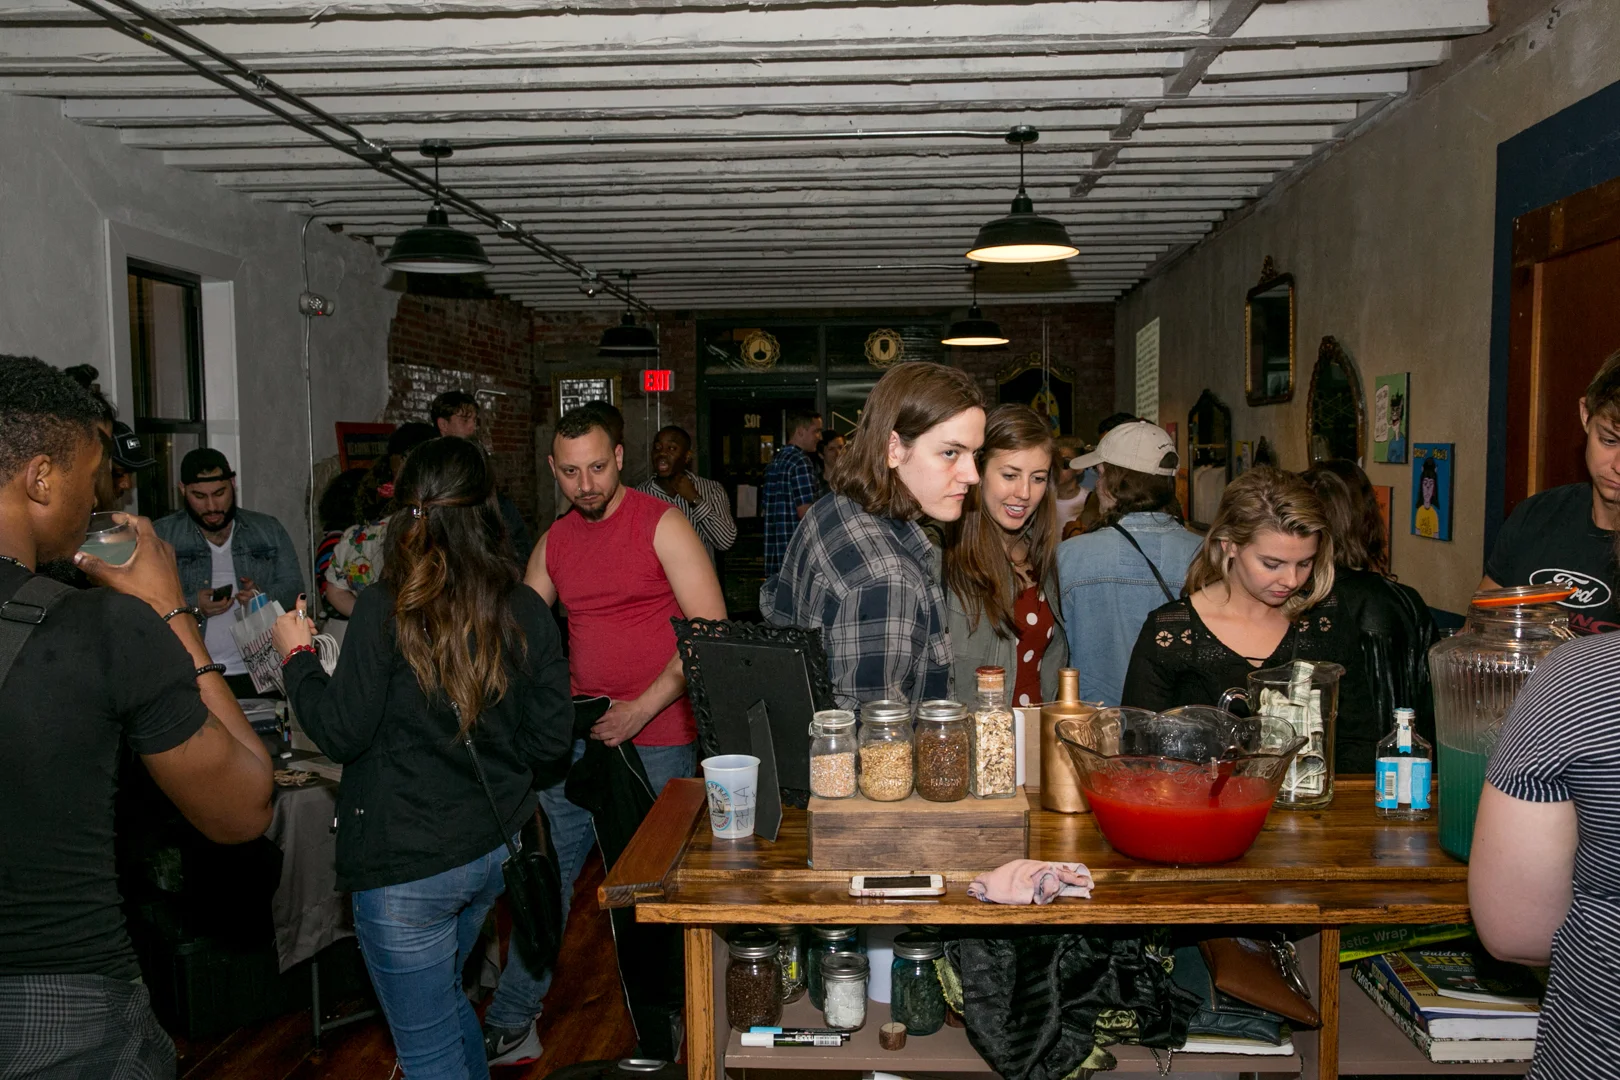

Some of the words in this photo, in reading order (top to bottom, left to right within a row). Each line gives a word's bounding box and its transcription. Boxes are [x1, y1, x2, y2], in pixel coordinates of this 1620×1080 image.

[644, 370, 671, 392] EXIT
[1340, 935, 1370, 949] astic
[1373, 928, 1408, 943] Wrap
